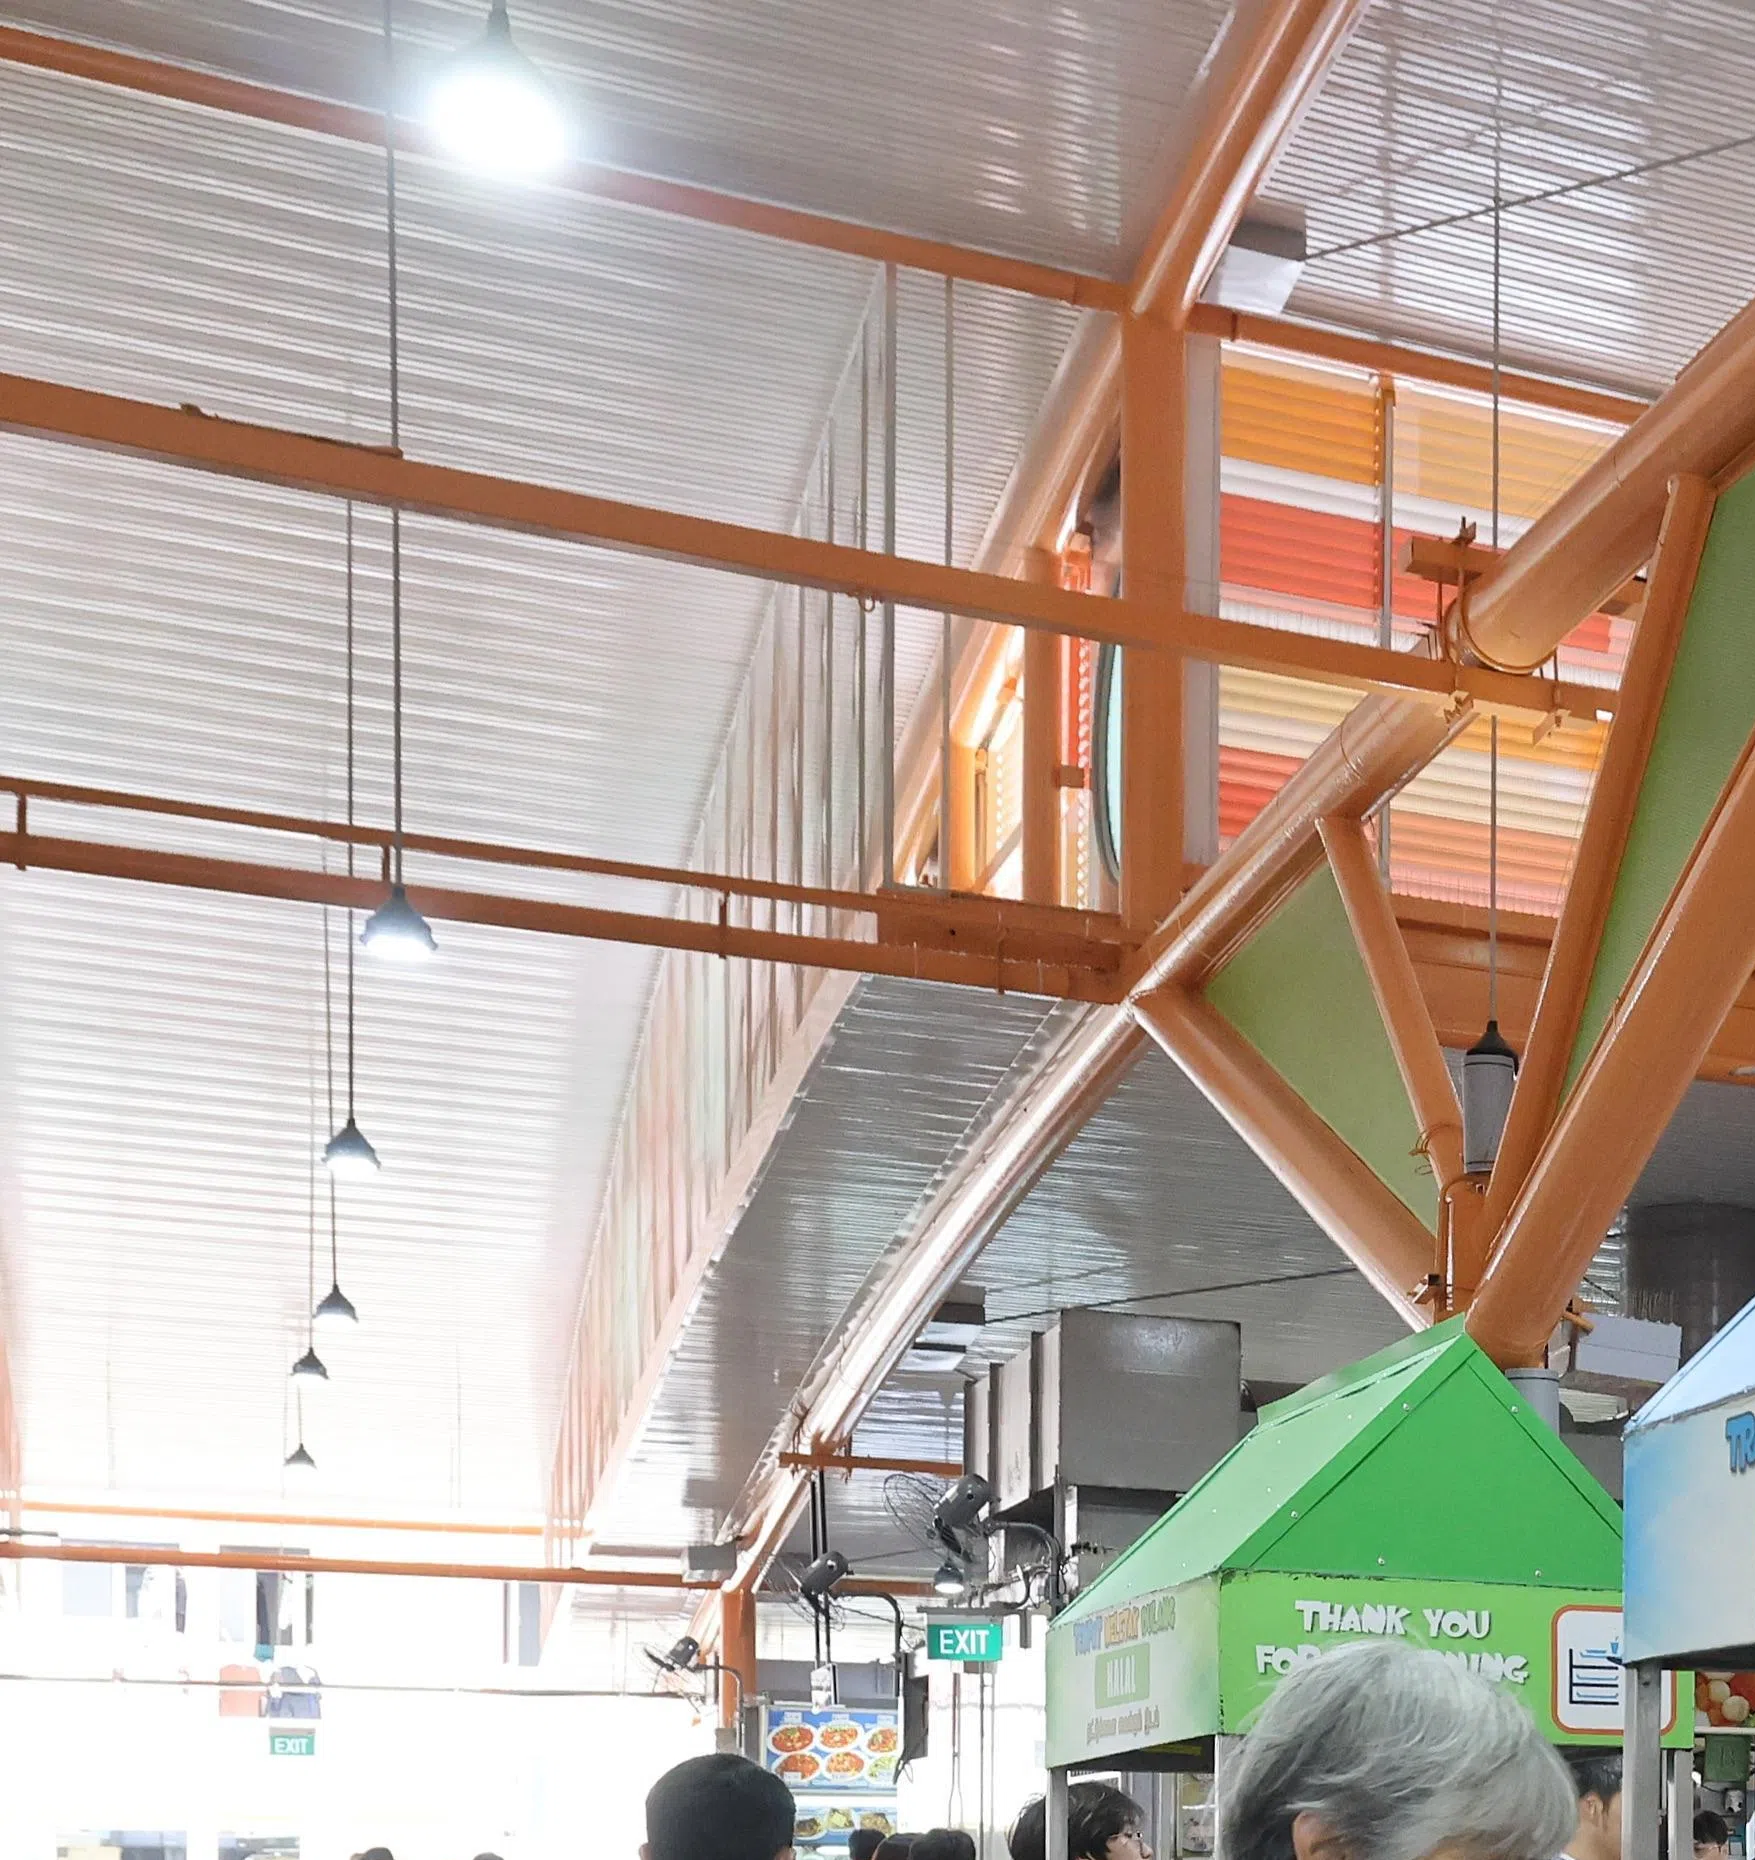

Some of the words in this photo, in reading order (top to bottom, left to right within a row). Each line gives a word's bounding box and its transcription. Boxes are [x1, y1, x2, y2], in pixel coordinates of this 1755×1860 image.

[1295, 1600, 1412, 1635] THANK
[1422, 1608, 1491, 1639] YOU
[940, 1629, 990, 1655] EXIT
[275, 1738, 308, 1754] EXIT
